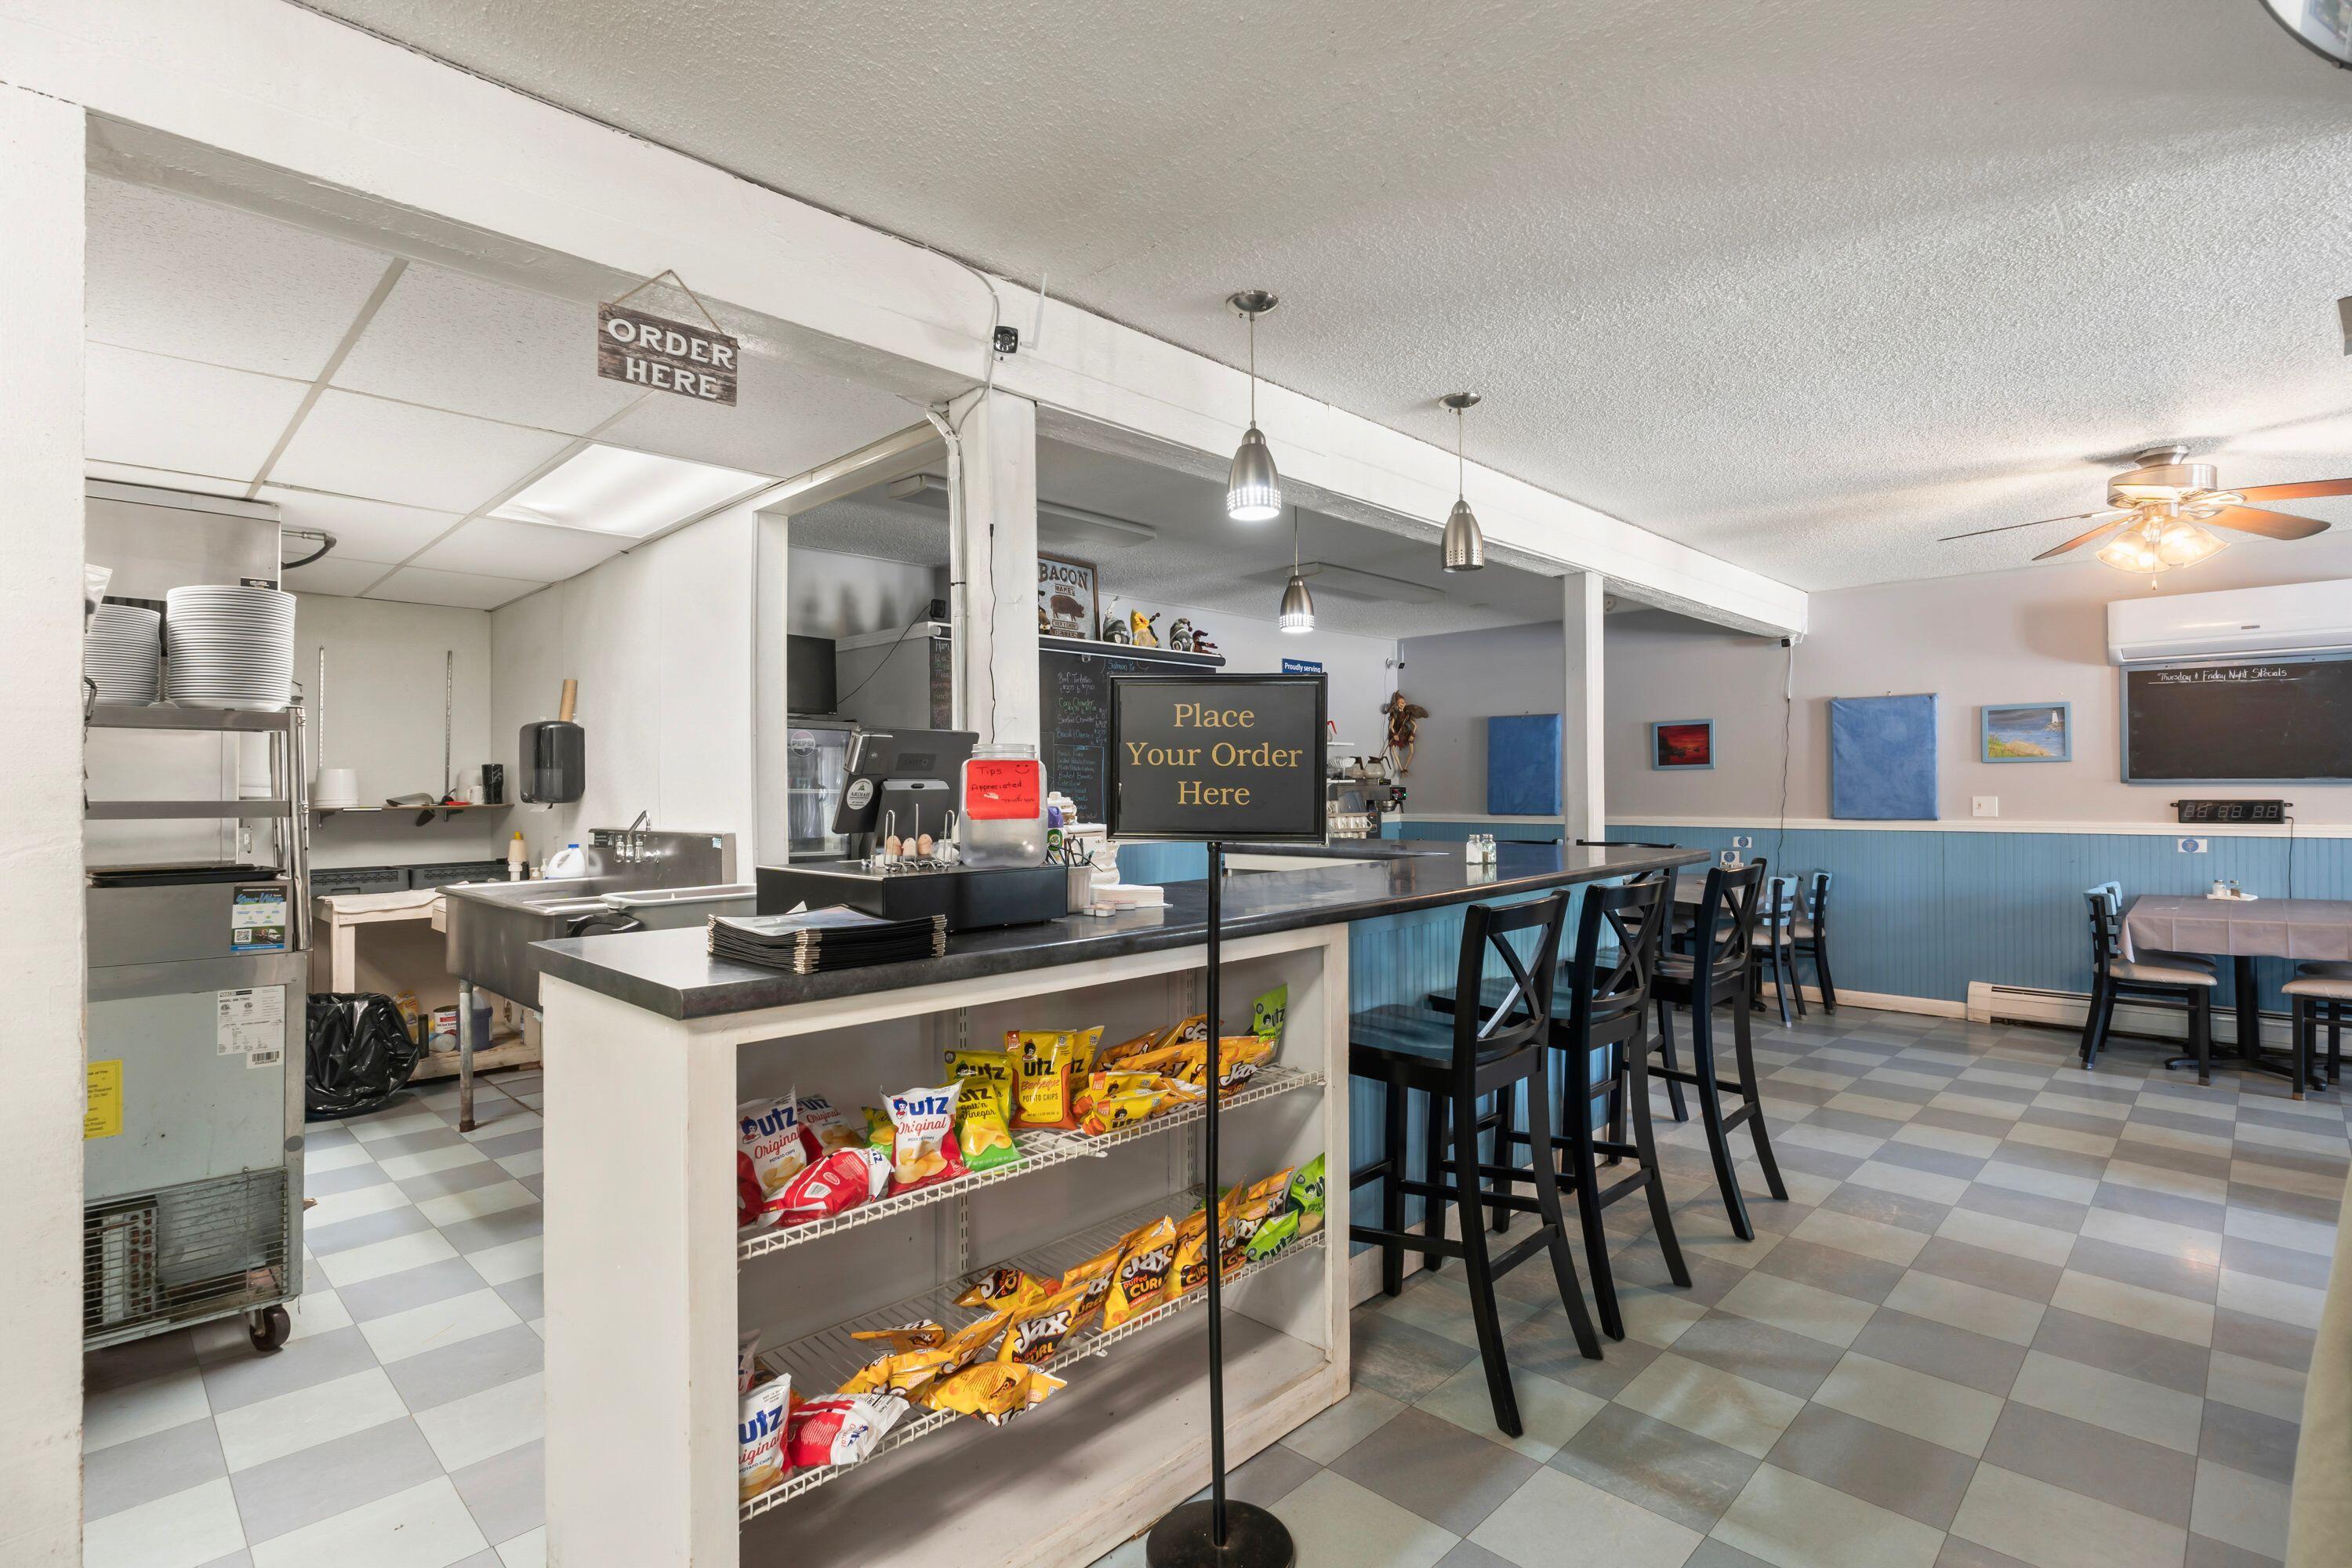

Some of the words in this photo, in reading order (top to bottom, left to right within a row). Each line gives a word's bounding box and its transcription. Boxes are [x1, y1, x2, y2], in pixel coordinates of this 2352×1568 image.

[608, 318, 735, 369] ORDER
[626, 357, 717, 399] HERE
[1038, 562, 1088, 590] BACON
[1055, 585, 1075, 594] MAKES
[1054, 629, 1078, 637] BETTER
[1108, 659, 1127, 670] Salmon
[1284, 662, 1303, 673] Proudly
[2158, 672, 2191, 682] Thursday
[2203, 670, 2226, 681] Friday
[2229, 669, 2249, 680] Night
[1073, 697, 1094, 706] Chowder
[1173, 702, 1254, 728] Place
[1126, 742, 1201, 766] Your
[1211, 742, 1303, 768] Order
[976, 767, 1002, 776] Tips
[971, 779, 1022, 792] Appreciated
[1178, 781, 1250, 805] Here
[1071, 1057, 1084, 1073] tz
[959, 1109, 996, 1120] Vinegar
[898, 1117, 946, 1136] Original
[754, 1127, 800, 1159] Original
[769, 1153, 785, 1163] POTATO
[1121, 1244, 1173, 1280] Jax
[1123, 1274, 1147, 1289] puffed
[1186, 1265, 1208, 1283] CUR
[1085, 1270, 1113, 1295] ax
[1014, 1309, 1072, 1354] Jax
[739, 1462, 759, 1473] POTATO
[759, 1457, 772, 1465] CHIPS
